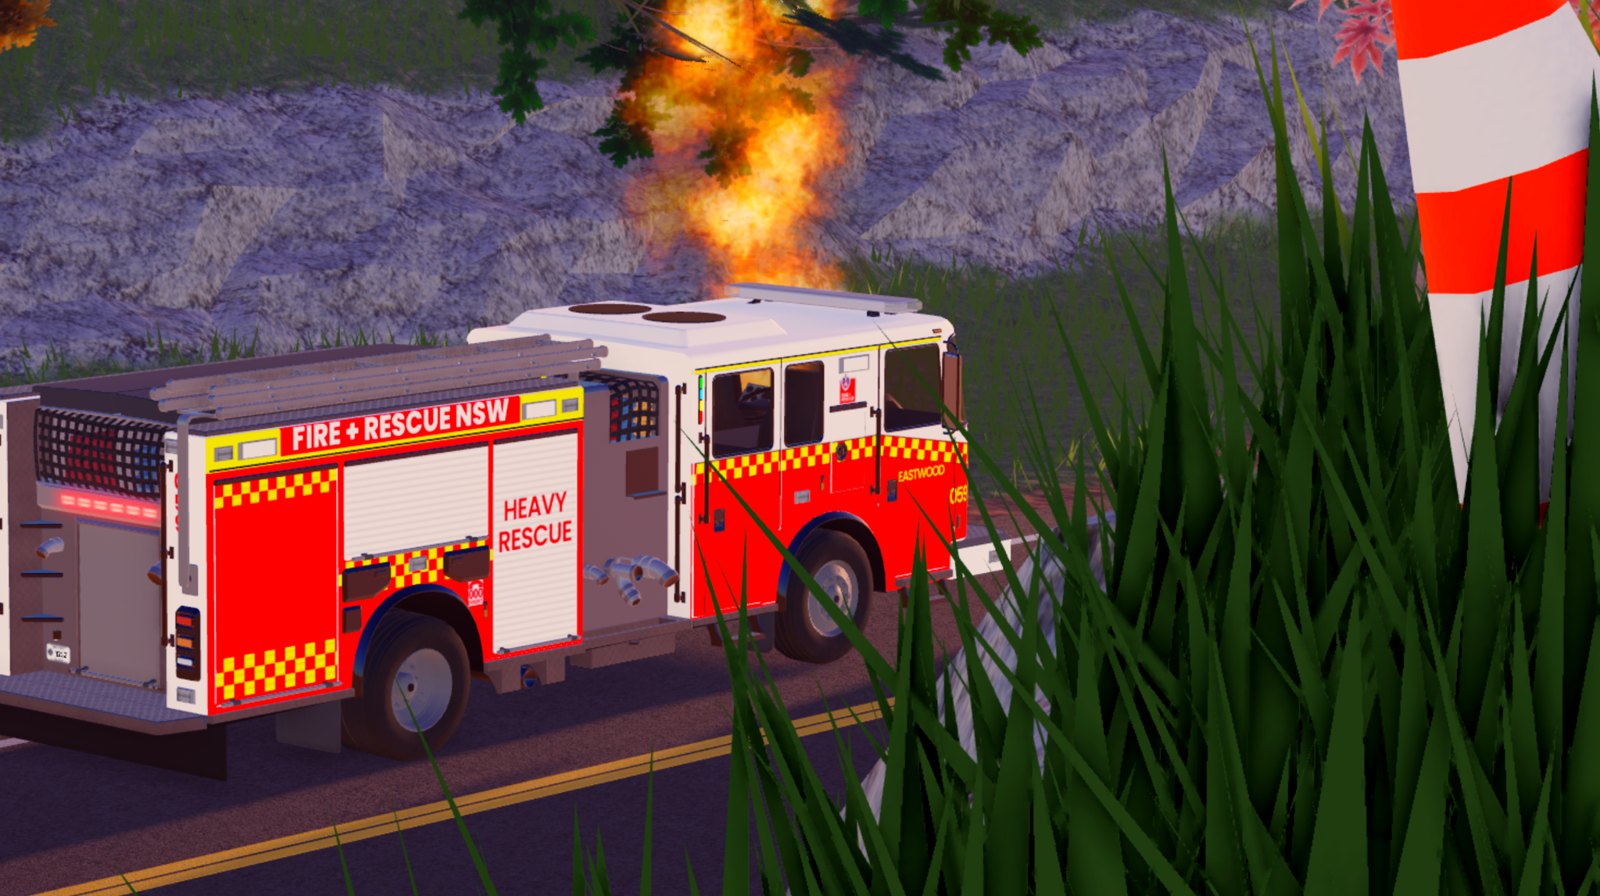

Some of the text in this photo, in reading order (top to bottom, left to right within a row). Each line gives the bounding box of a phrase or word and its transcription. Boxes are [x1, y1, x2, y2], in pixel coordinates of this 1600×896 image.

[292, 398, 509, 451] FIRE + RESCUE NSW
[898, 464, 946, 483] EASTWOOD
[504, 490, 567, 521] HEAVY
[498, 520, 572, 553] RESCUE
